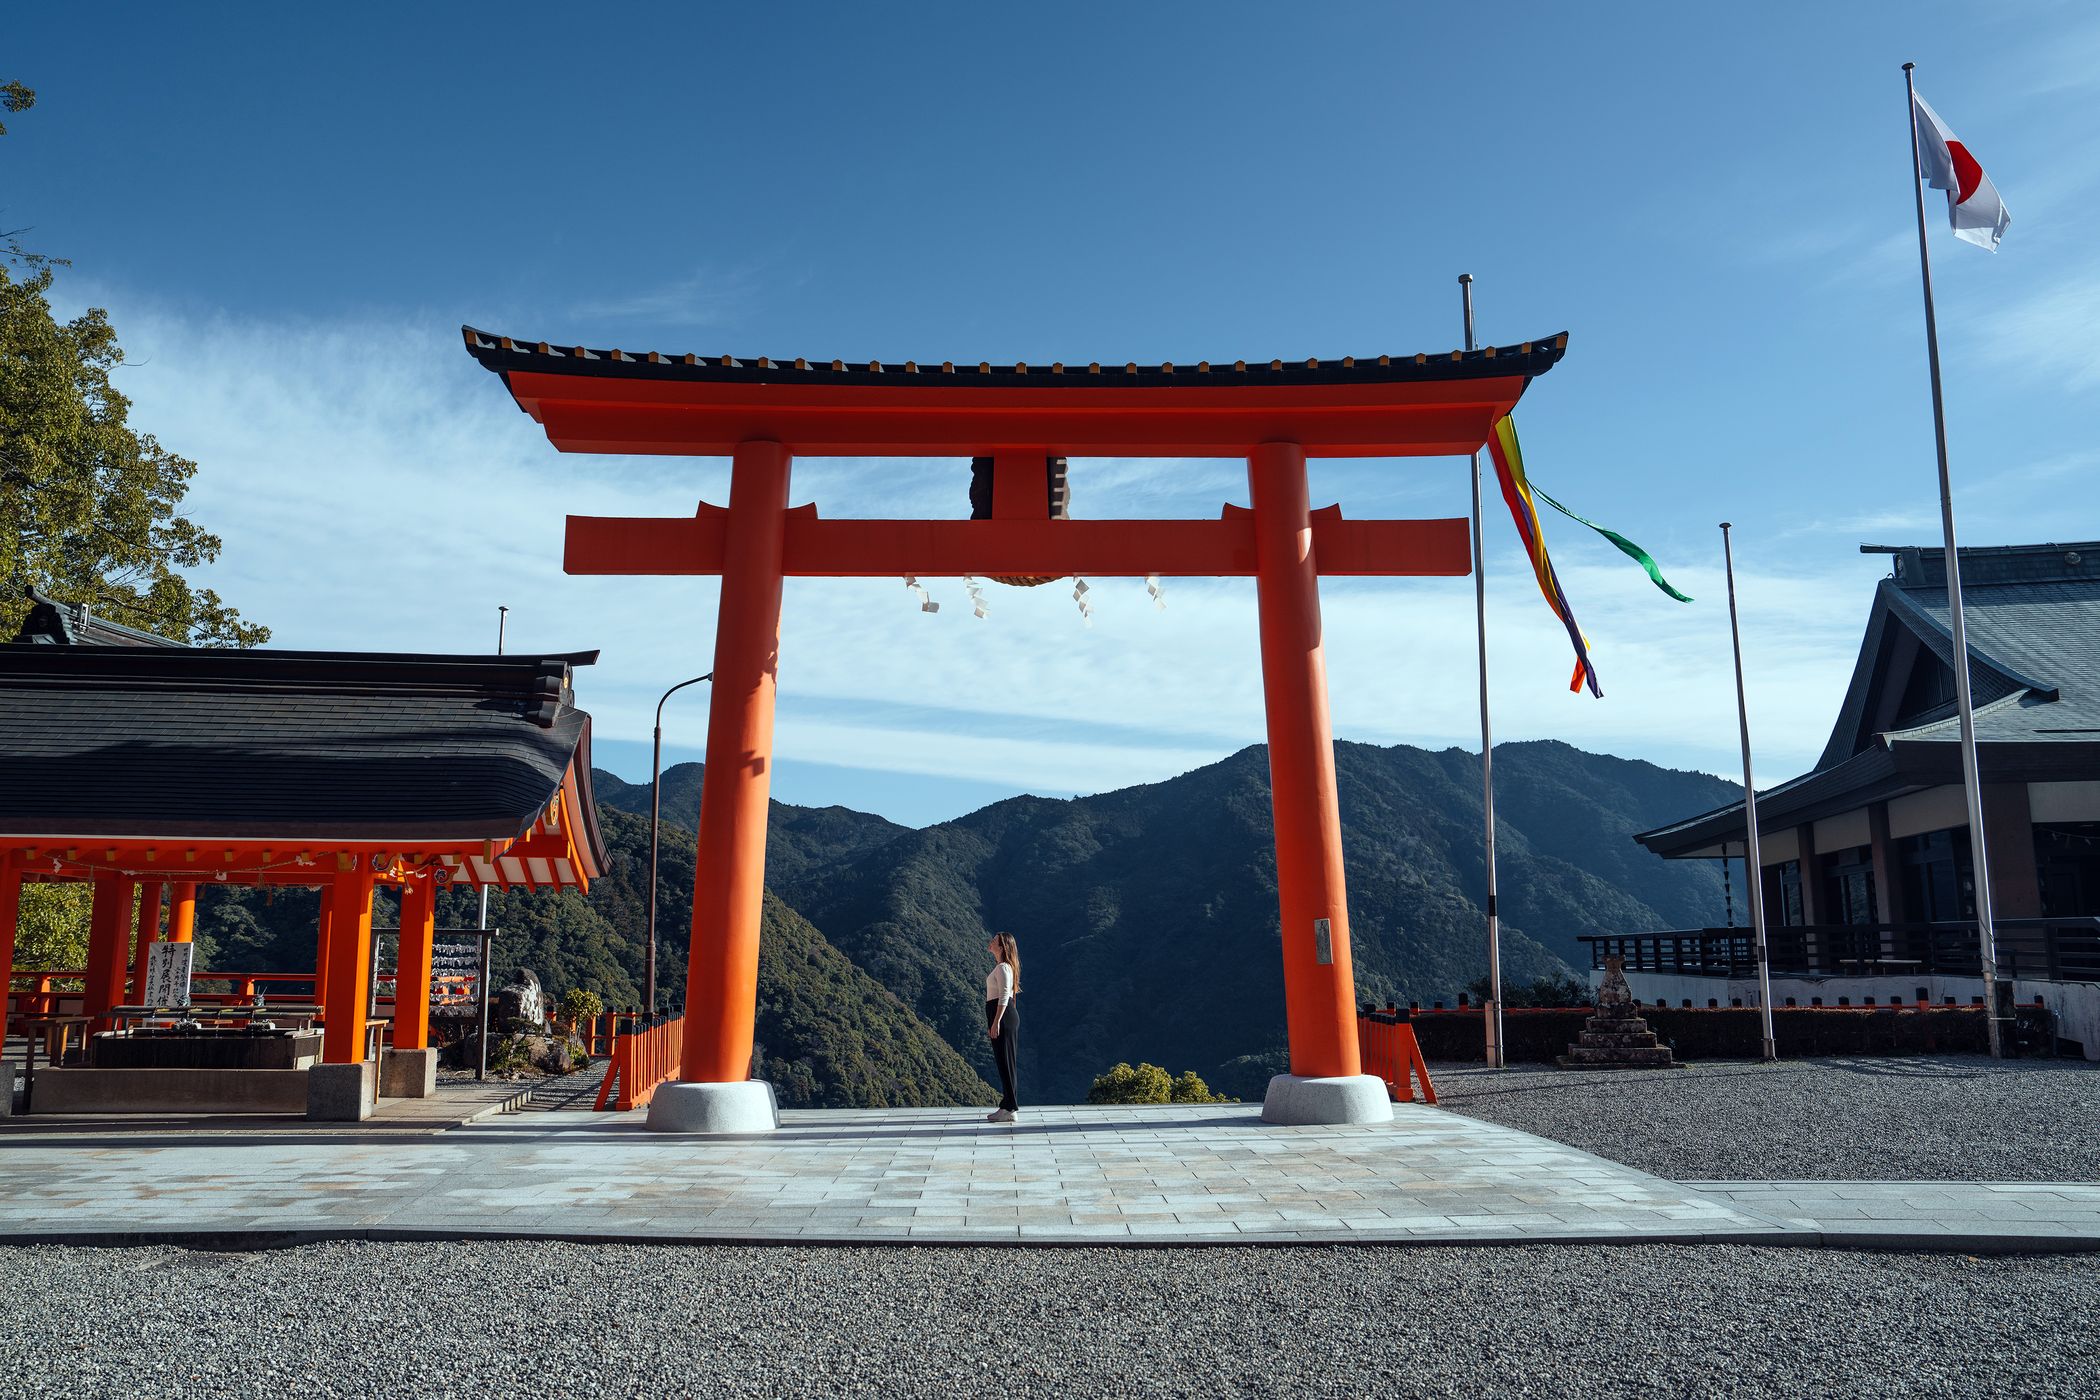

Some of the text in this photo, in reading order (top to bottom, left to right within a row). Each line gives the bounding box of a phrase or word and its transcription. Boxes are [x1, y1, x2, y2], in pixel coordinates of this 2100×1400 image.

[157, 943, 176, 1007] 特別展開催
